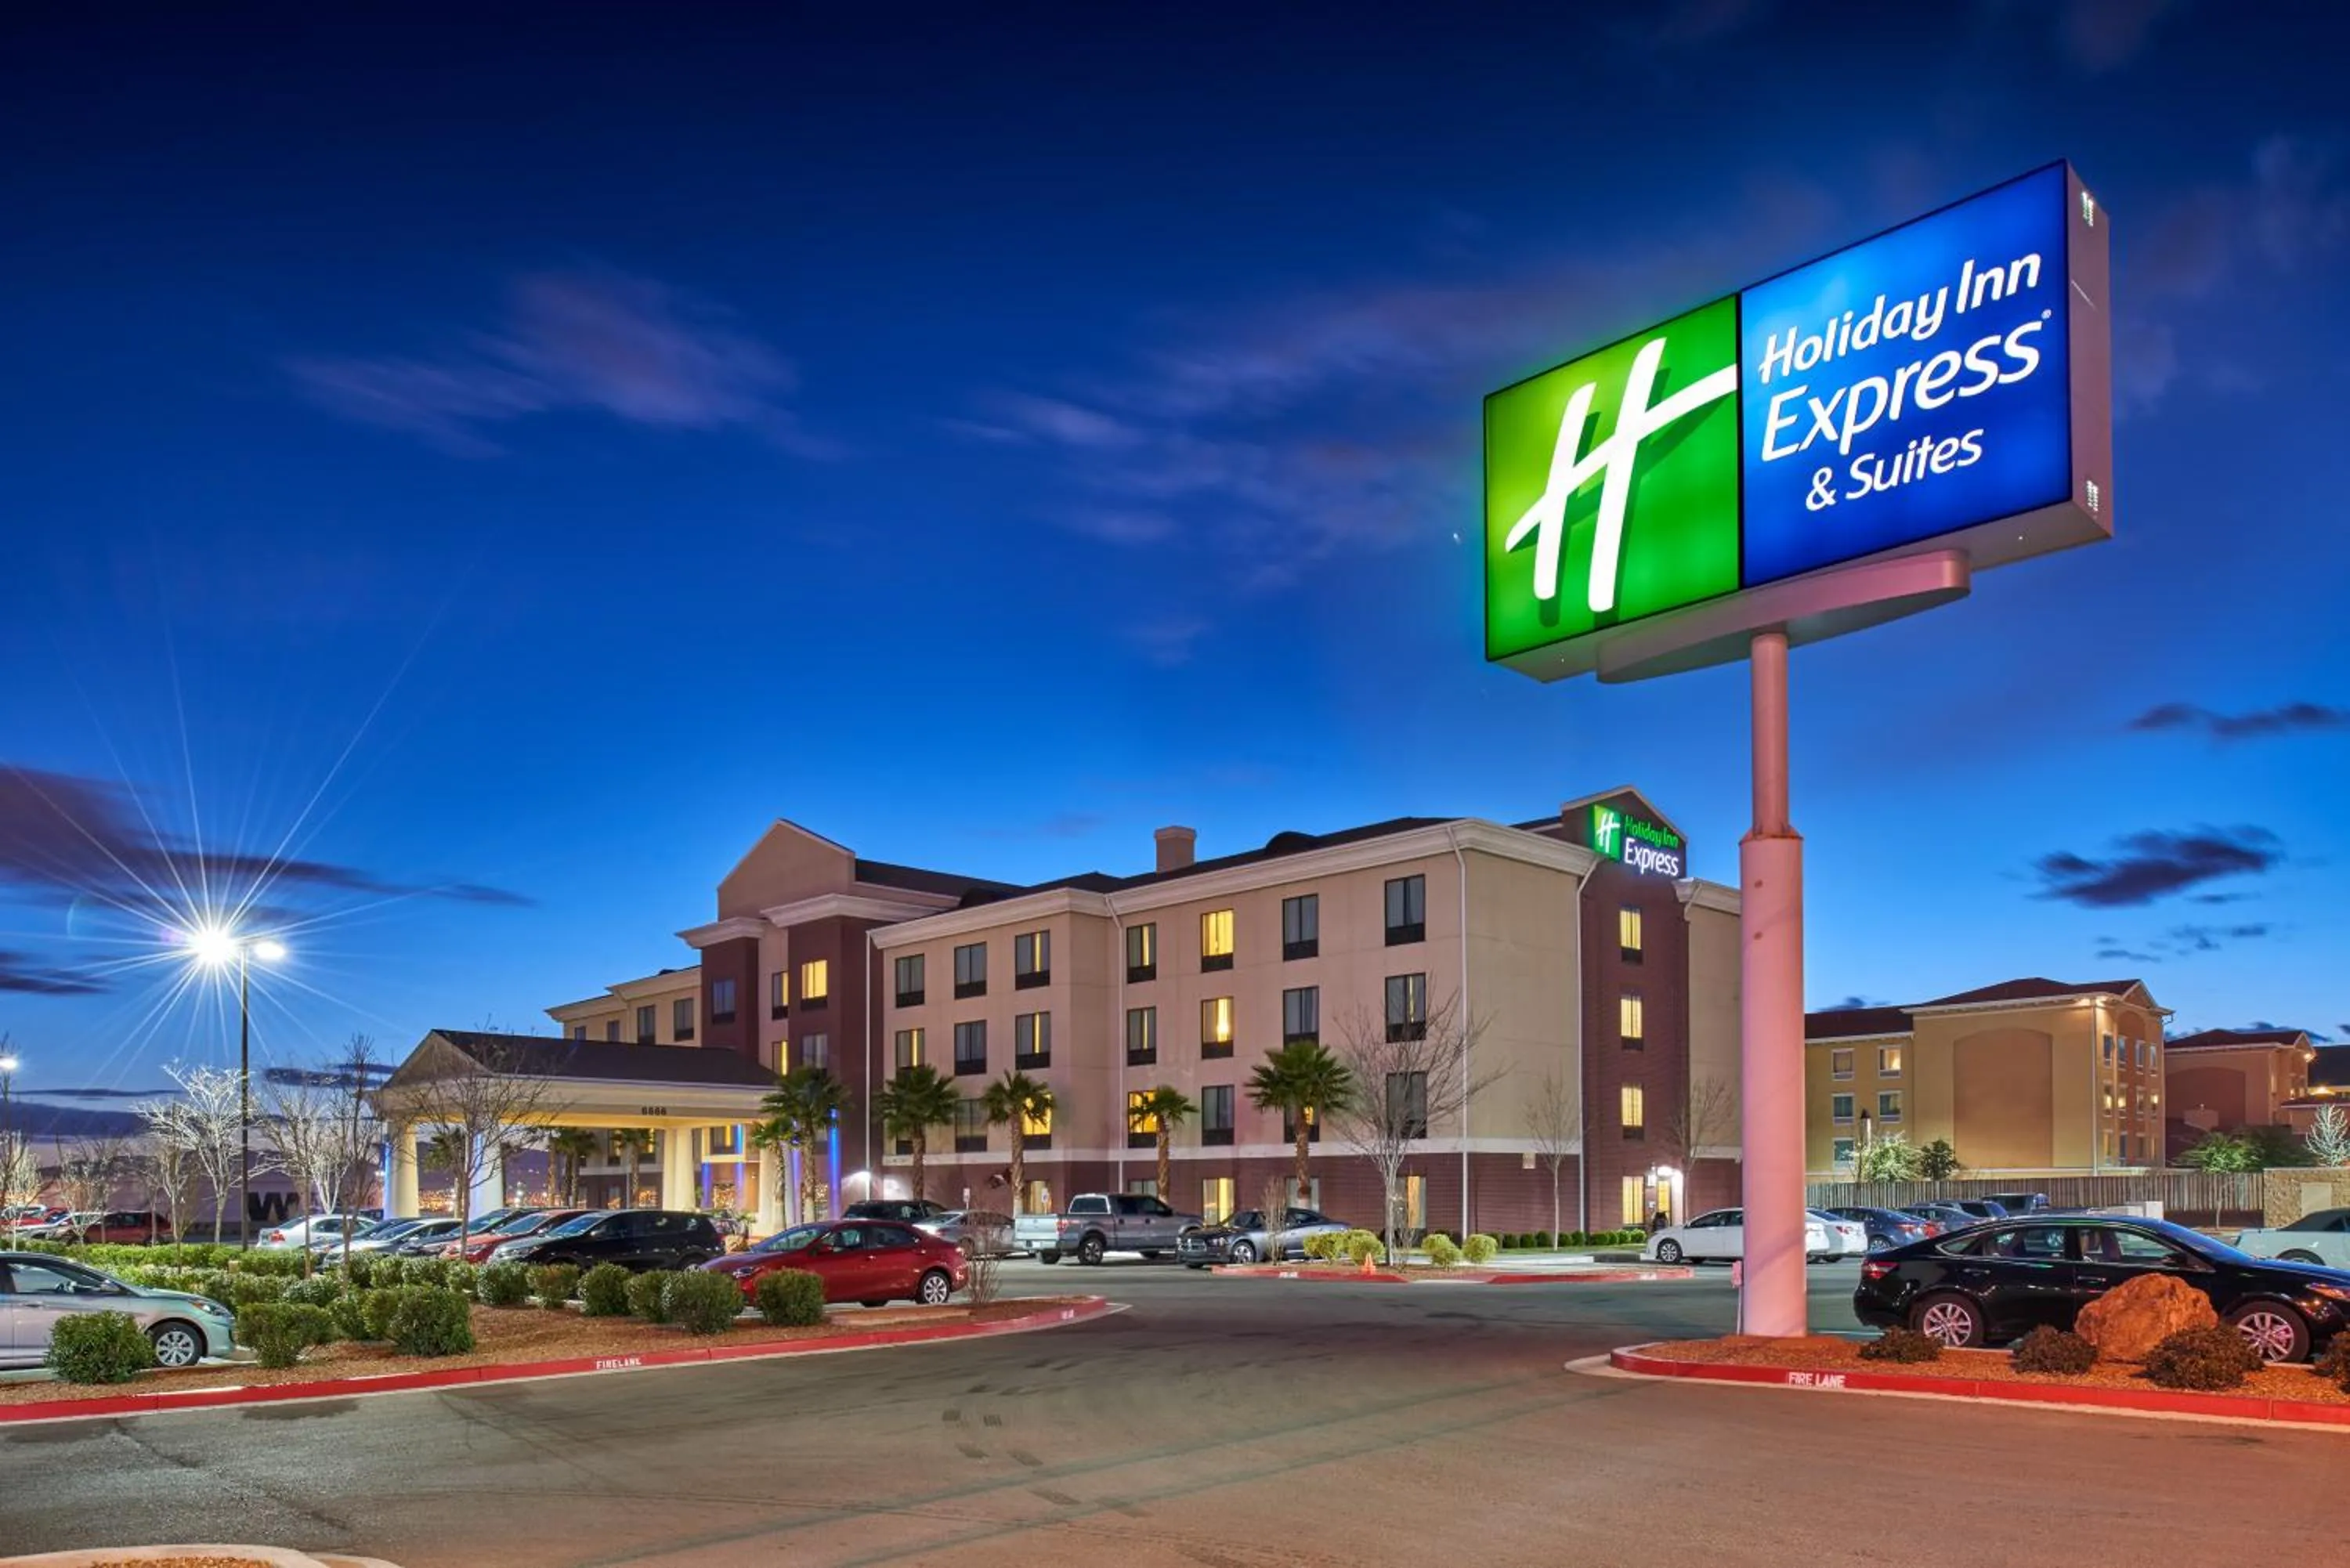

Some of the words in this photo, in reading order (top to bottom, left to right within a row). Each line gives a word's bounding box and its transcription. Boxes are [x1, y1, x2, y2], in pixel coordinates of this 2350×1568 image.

[1757, 286, 1949, 385] Holiday
[1955, 253, 2041, 314] Inn
[1761, 320, 2044, 462] Express
[1805, 466, 1837, 511] &
[1845, 428, 1984, 500] Suites
[1623, 836, 1679, 877] Express
[1624, 814, 1661, 849] Holiday
[1662, 826, 1679, 849] Inn
[1788, 1371, 1813, 1386] FIRE
[1815, 1373, 1846, 1389] LANE
